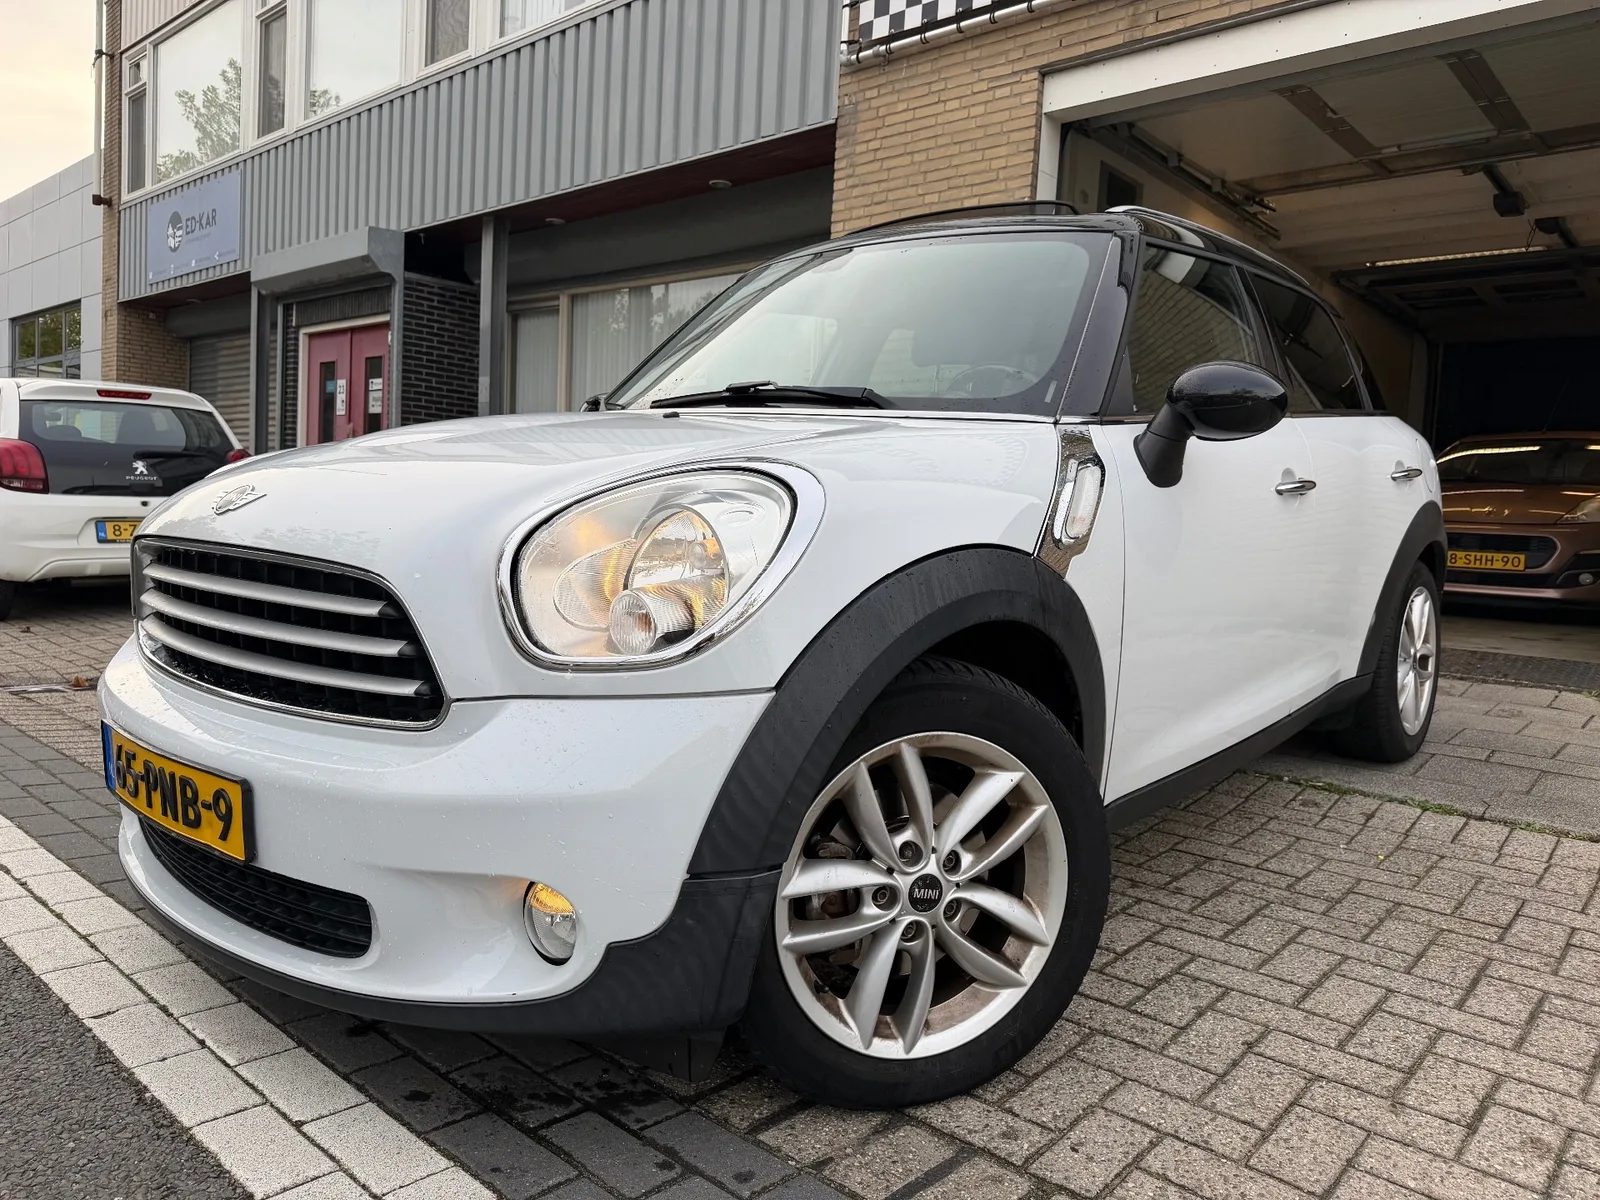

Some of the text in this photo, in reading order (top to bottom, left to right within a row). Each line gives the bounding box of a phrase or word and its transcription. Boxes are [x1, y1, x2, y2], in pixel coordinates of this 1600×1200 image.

[185, 208, 217, 235] ED-KAR
[1449, 553, 1521, 568] 8-SHH-90
[116, 743, 233, 841] 65-PNB-9
[913, 888, 939, 900] MINI
